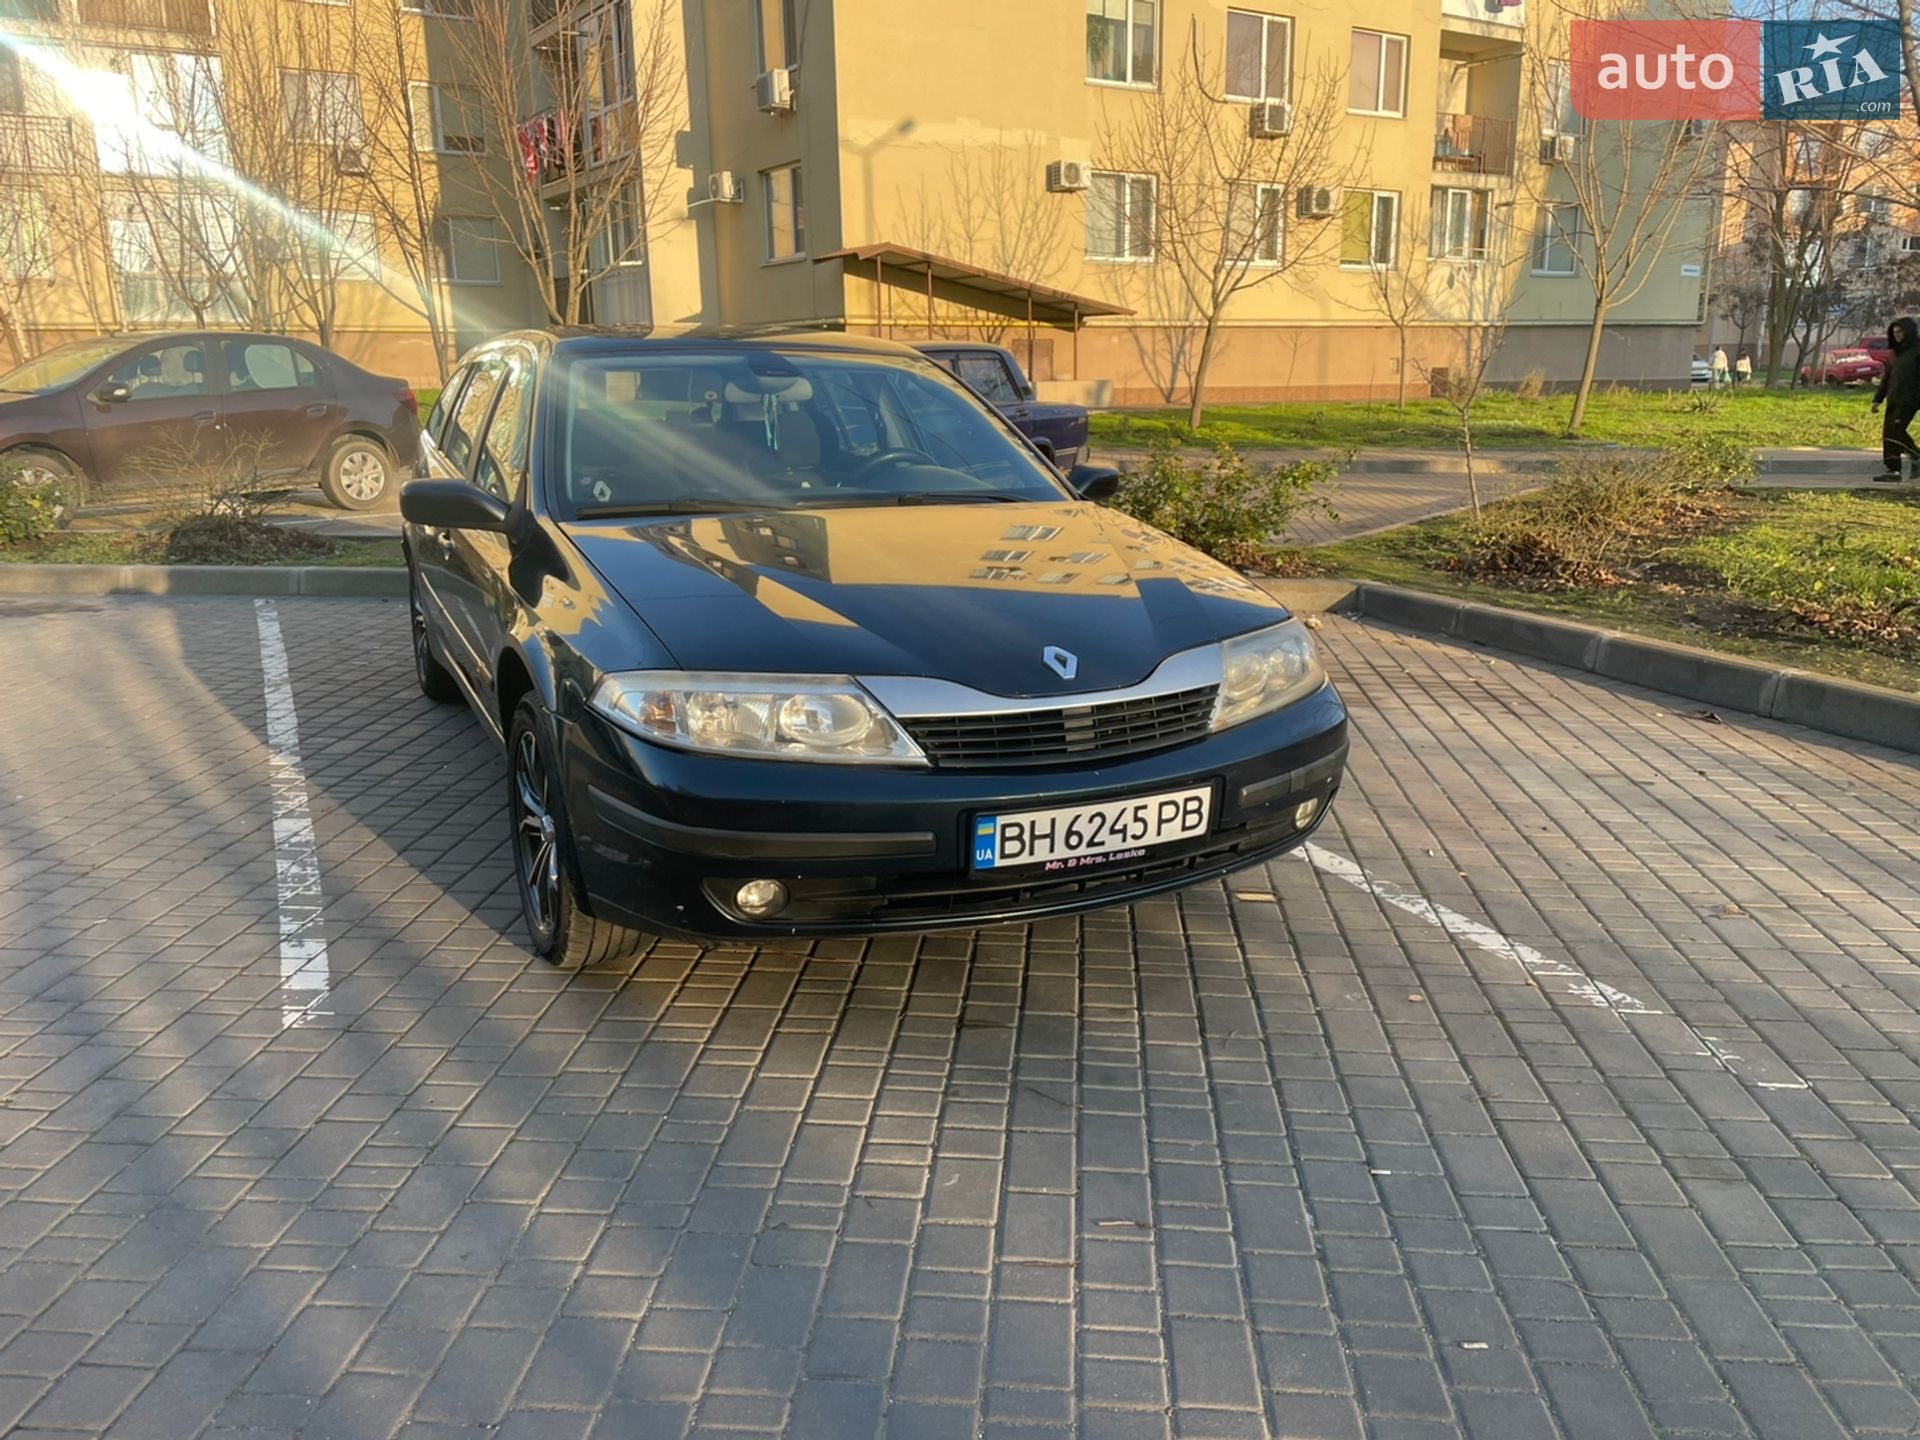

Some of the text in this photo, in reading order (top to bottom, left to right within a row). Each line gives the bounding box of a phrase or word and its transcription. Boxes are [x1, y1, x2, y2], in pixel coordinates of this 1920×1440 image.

[999, 795, 1204, 860] BH 6245 PB
[976, 848, 993, 861] UA
